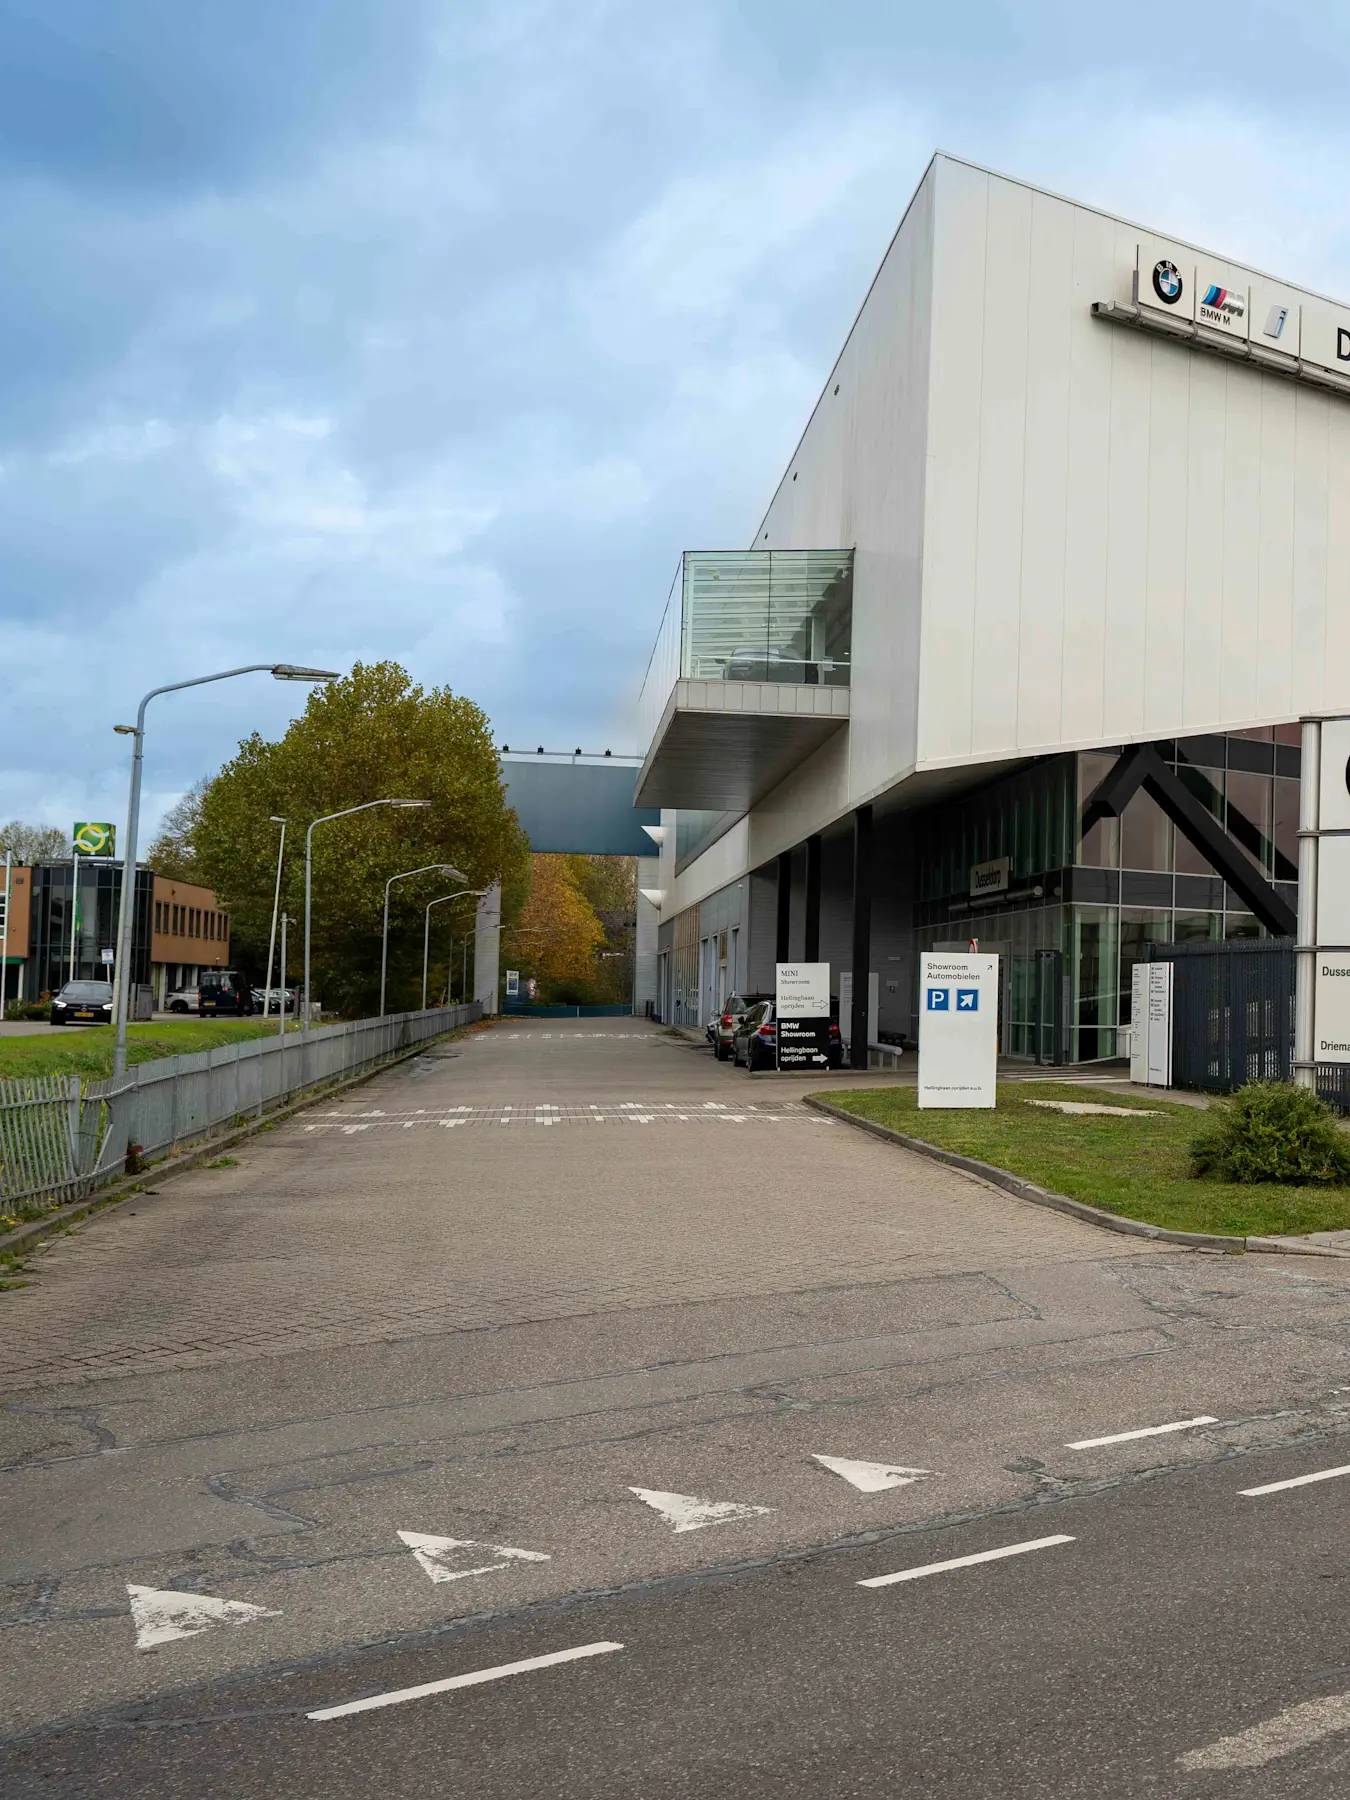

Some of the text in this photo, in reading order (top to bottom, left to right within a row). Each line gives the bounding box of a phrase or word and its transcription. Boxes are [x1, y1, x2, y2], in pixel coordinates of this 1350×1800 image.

[1156, 261, 1182, 280] BMW
[1200, 306, 1222, 323] BMW
[1223, 315, 1231, 326] M
[927, 962, 969, 971] Showroom
[926, 972, 981, 980] Automobielen
[931, 990, 945, 1009] P
[780, 1022, 800, 1030] BMW
[780, 1046, 819, 1055] Hellingbaan
[780, 1055, 807, 1063] oprijden
